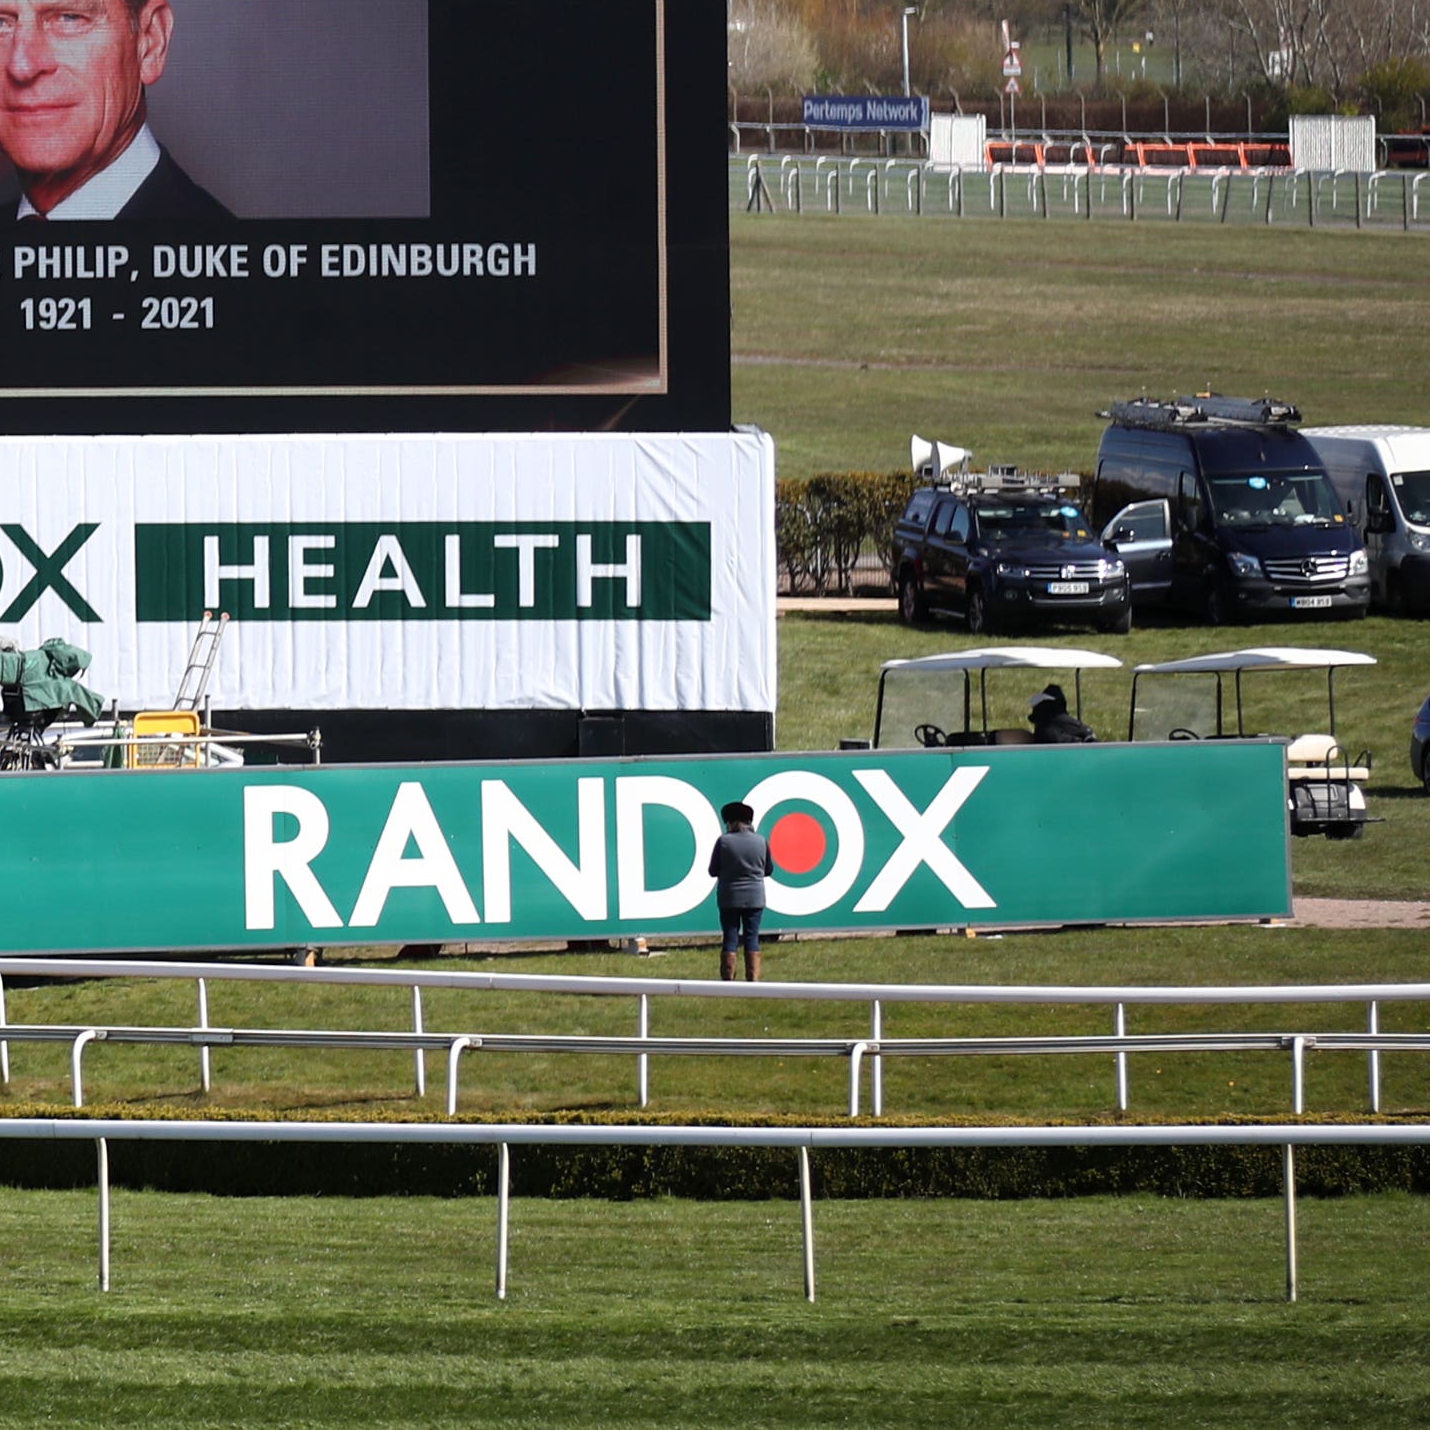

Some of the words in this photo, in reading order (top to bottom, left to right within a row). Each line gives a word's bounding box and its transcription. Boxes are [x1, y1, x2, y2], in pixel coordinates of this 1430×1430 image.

[804, 100, 863, 124] Pertemps
[867, 100, 918, 122] Network
[14, 246, 138, 282] PHILIP,
[153, 244, 249, 278] DUKE
[263, 244, 307, 277] OF
[320, 243, 537, 277] EDINBURGH
[20, 297, 91, 330] 1921
[141, 296, 215, 329] 2021
[203, 534, 642, 609] HEALTH
[243, 765, 997, 930] RANDOX
